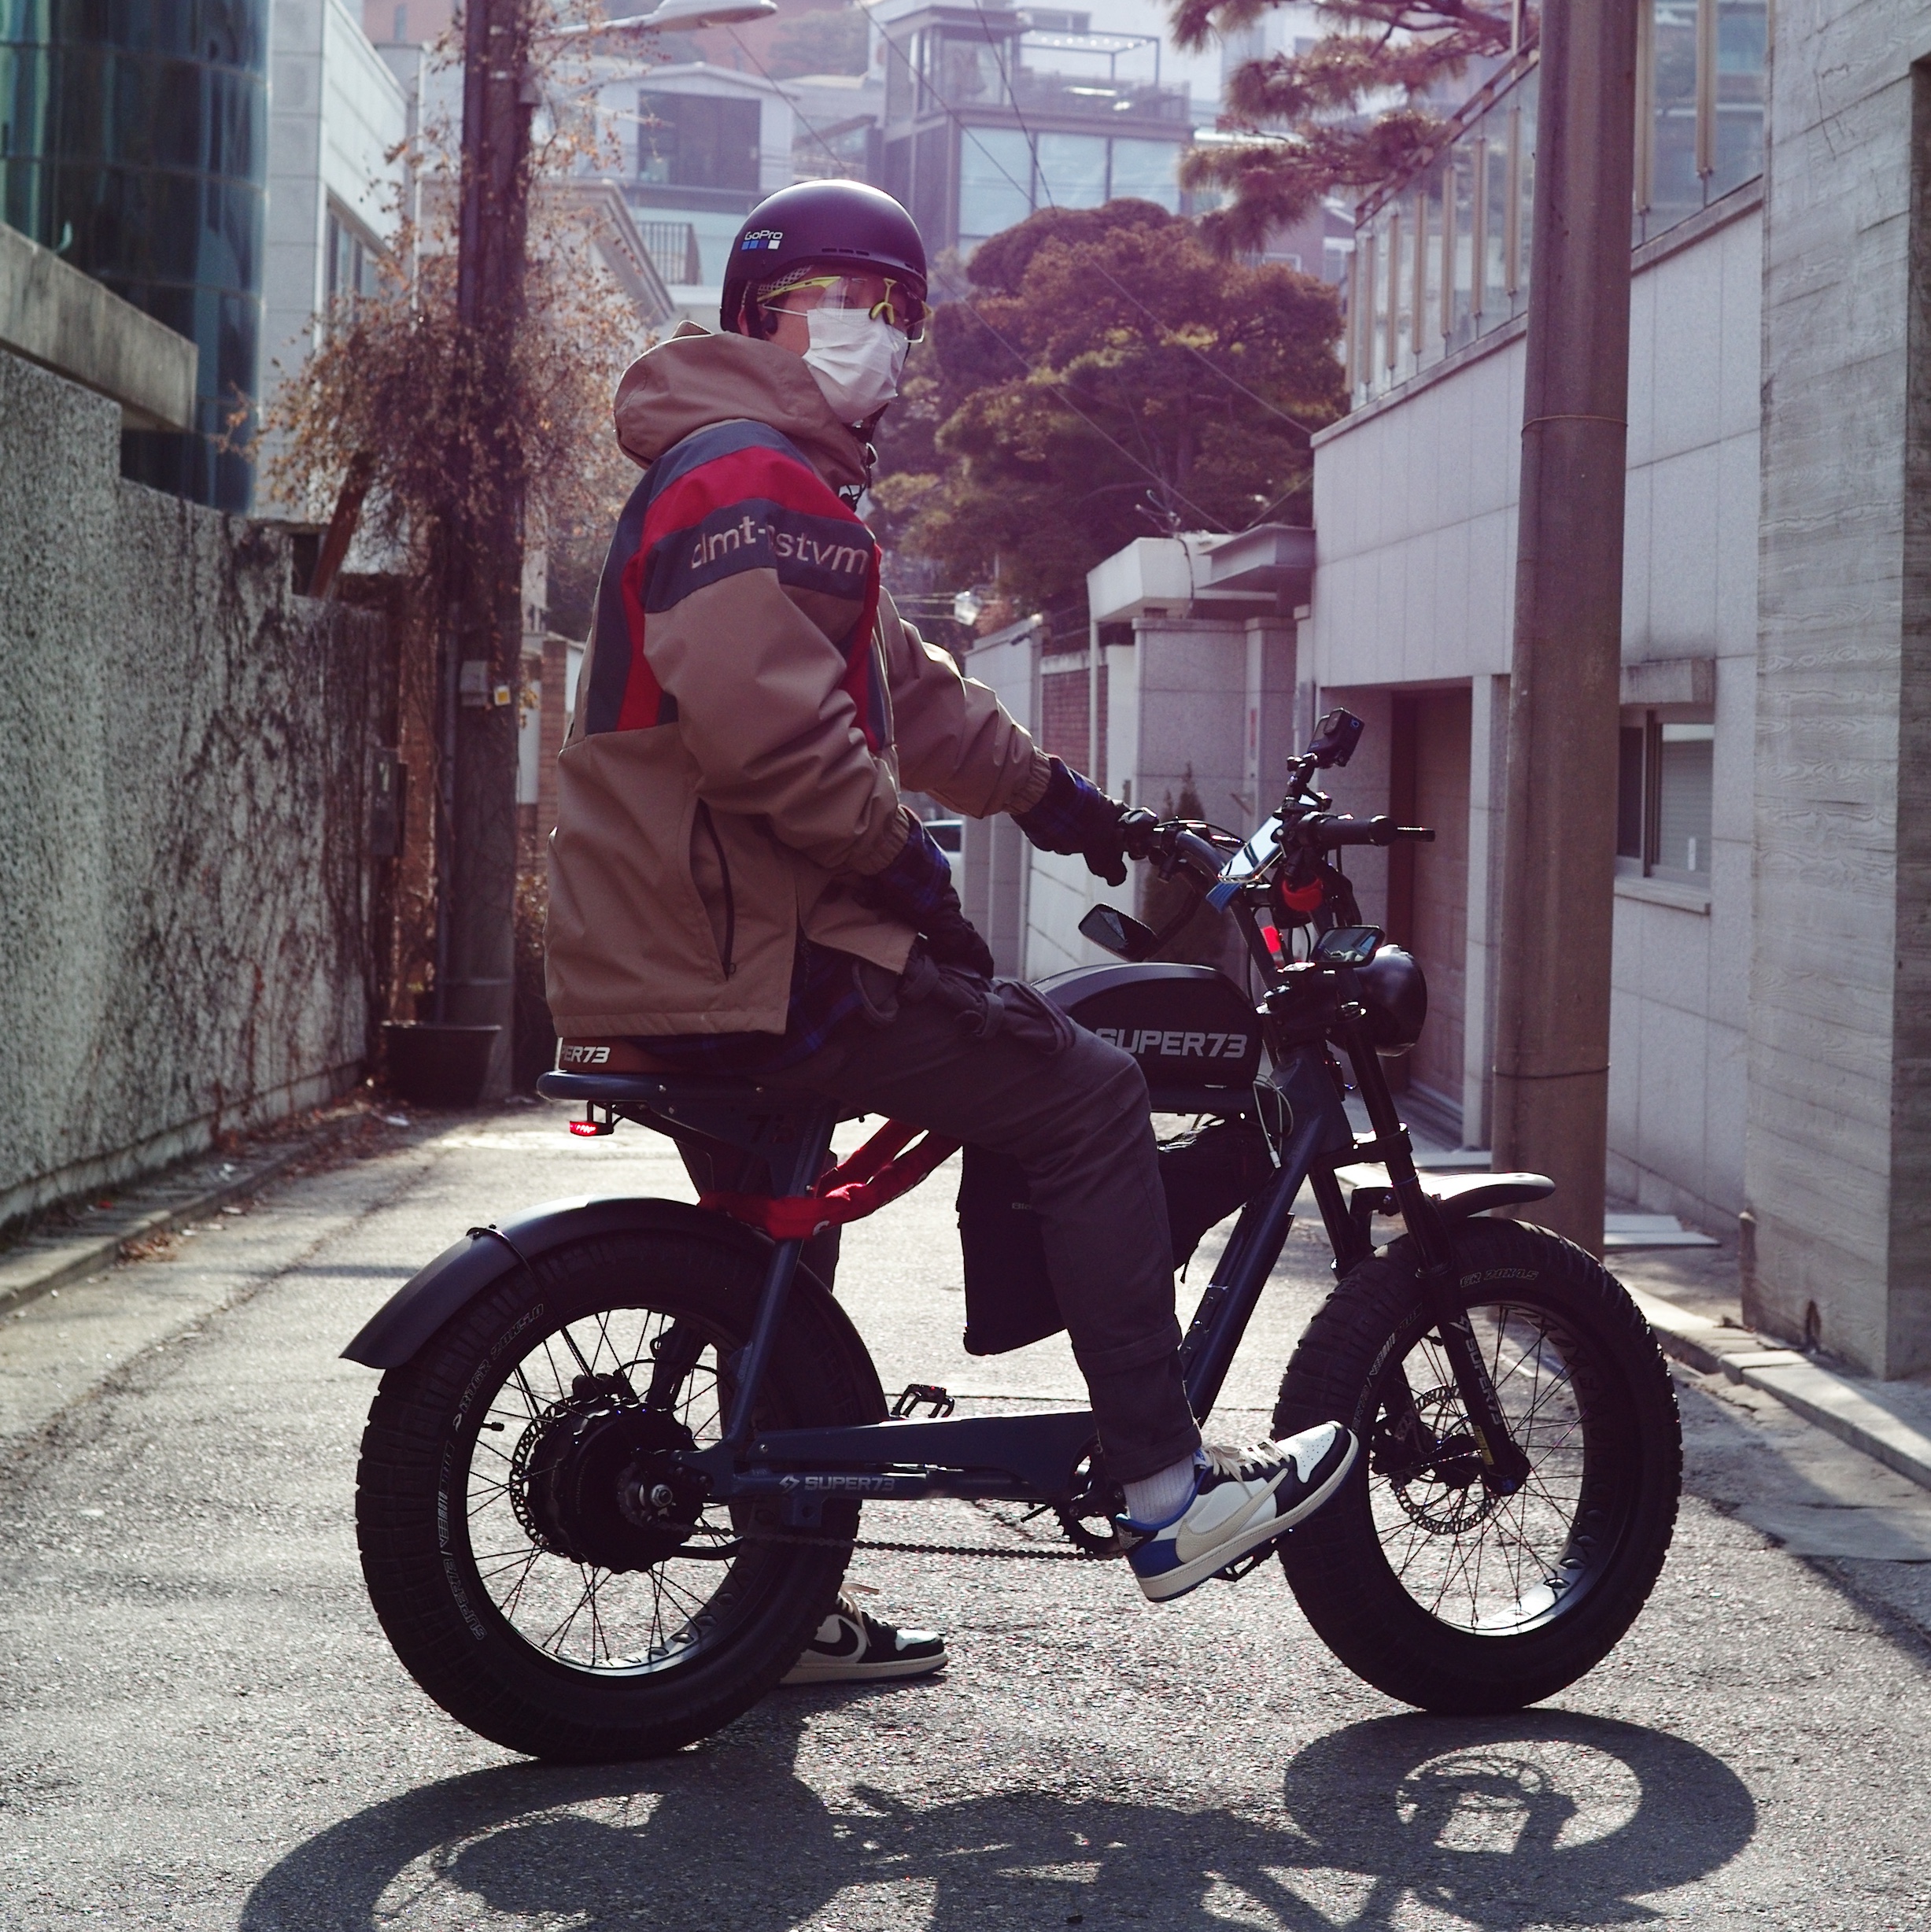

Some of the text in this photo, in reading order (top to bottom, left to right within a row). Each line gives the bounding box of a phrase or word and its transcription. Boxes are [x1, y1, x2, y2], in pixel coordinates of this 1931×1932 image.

[744, 229, 783, 241] GoPro
[1464, 1337, 1504, 1426] SUPER73
[803, 1476, 896, 1492] SUPER73
[442, 1557, 488, 1642] SUPER73
